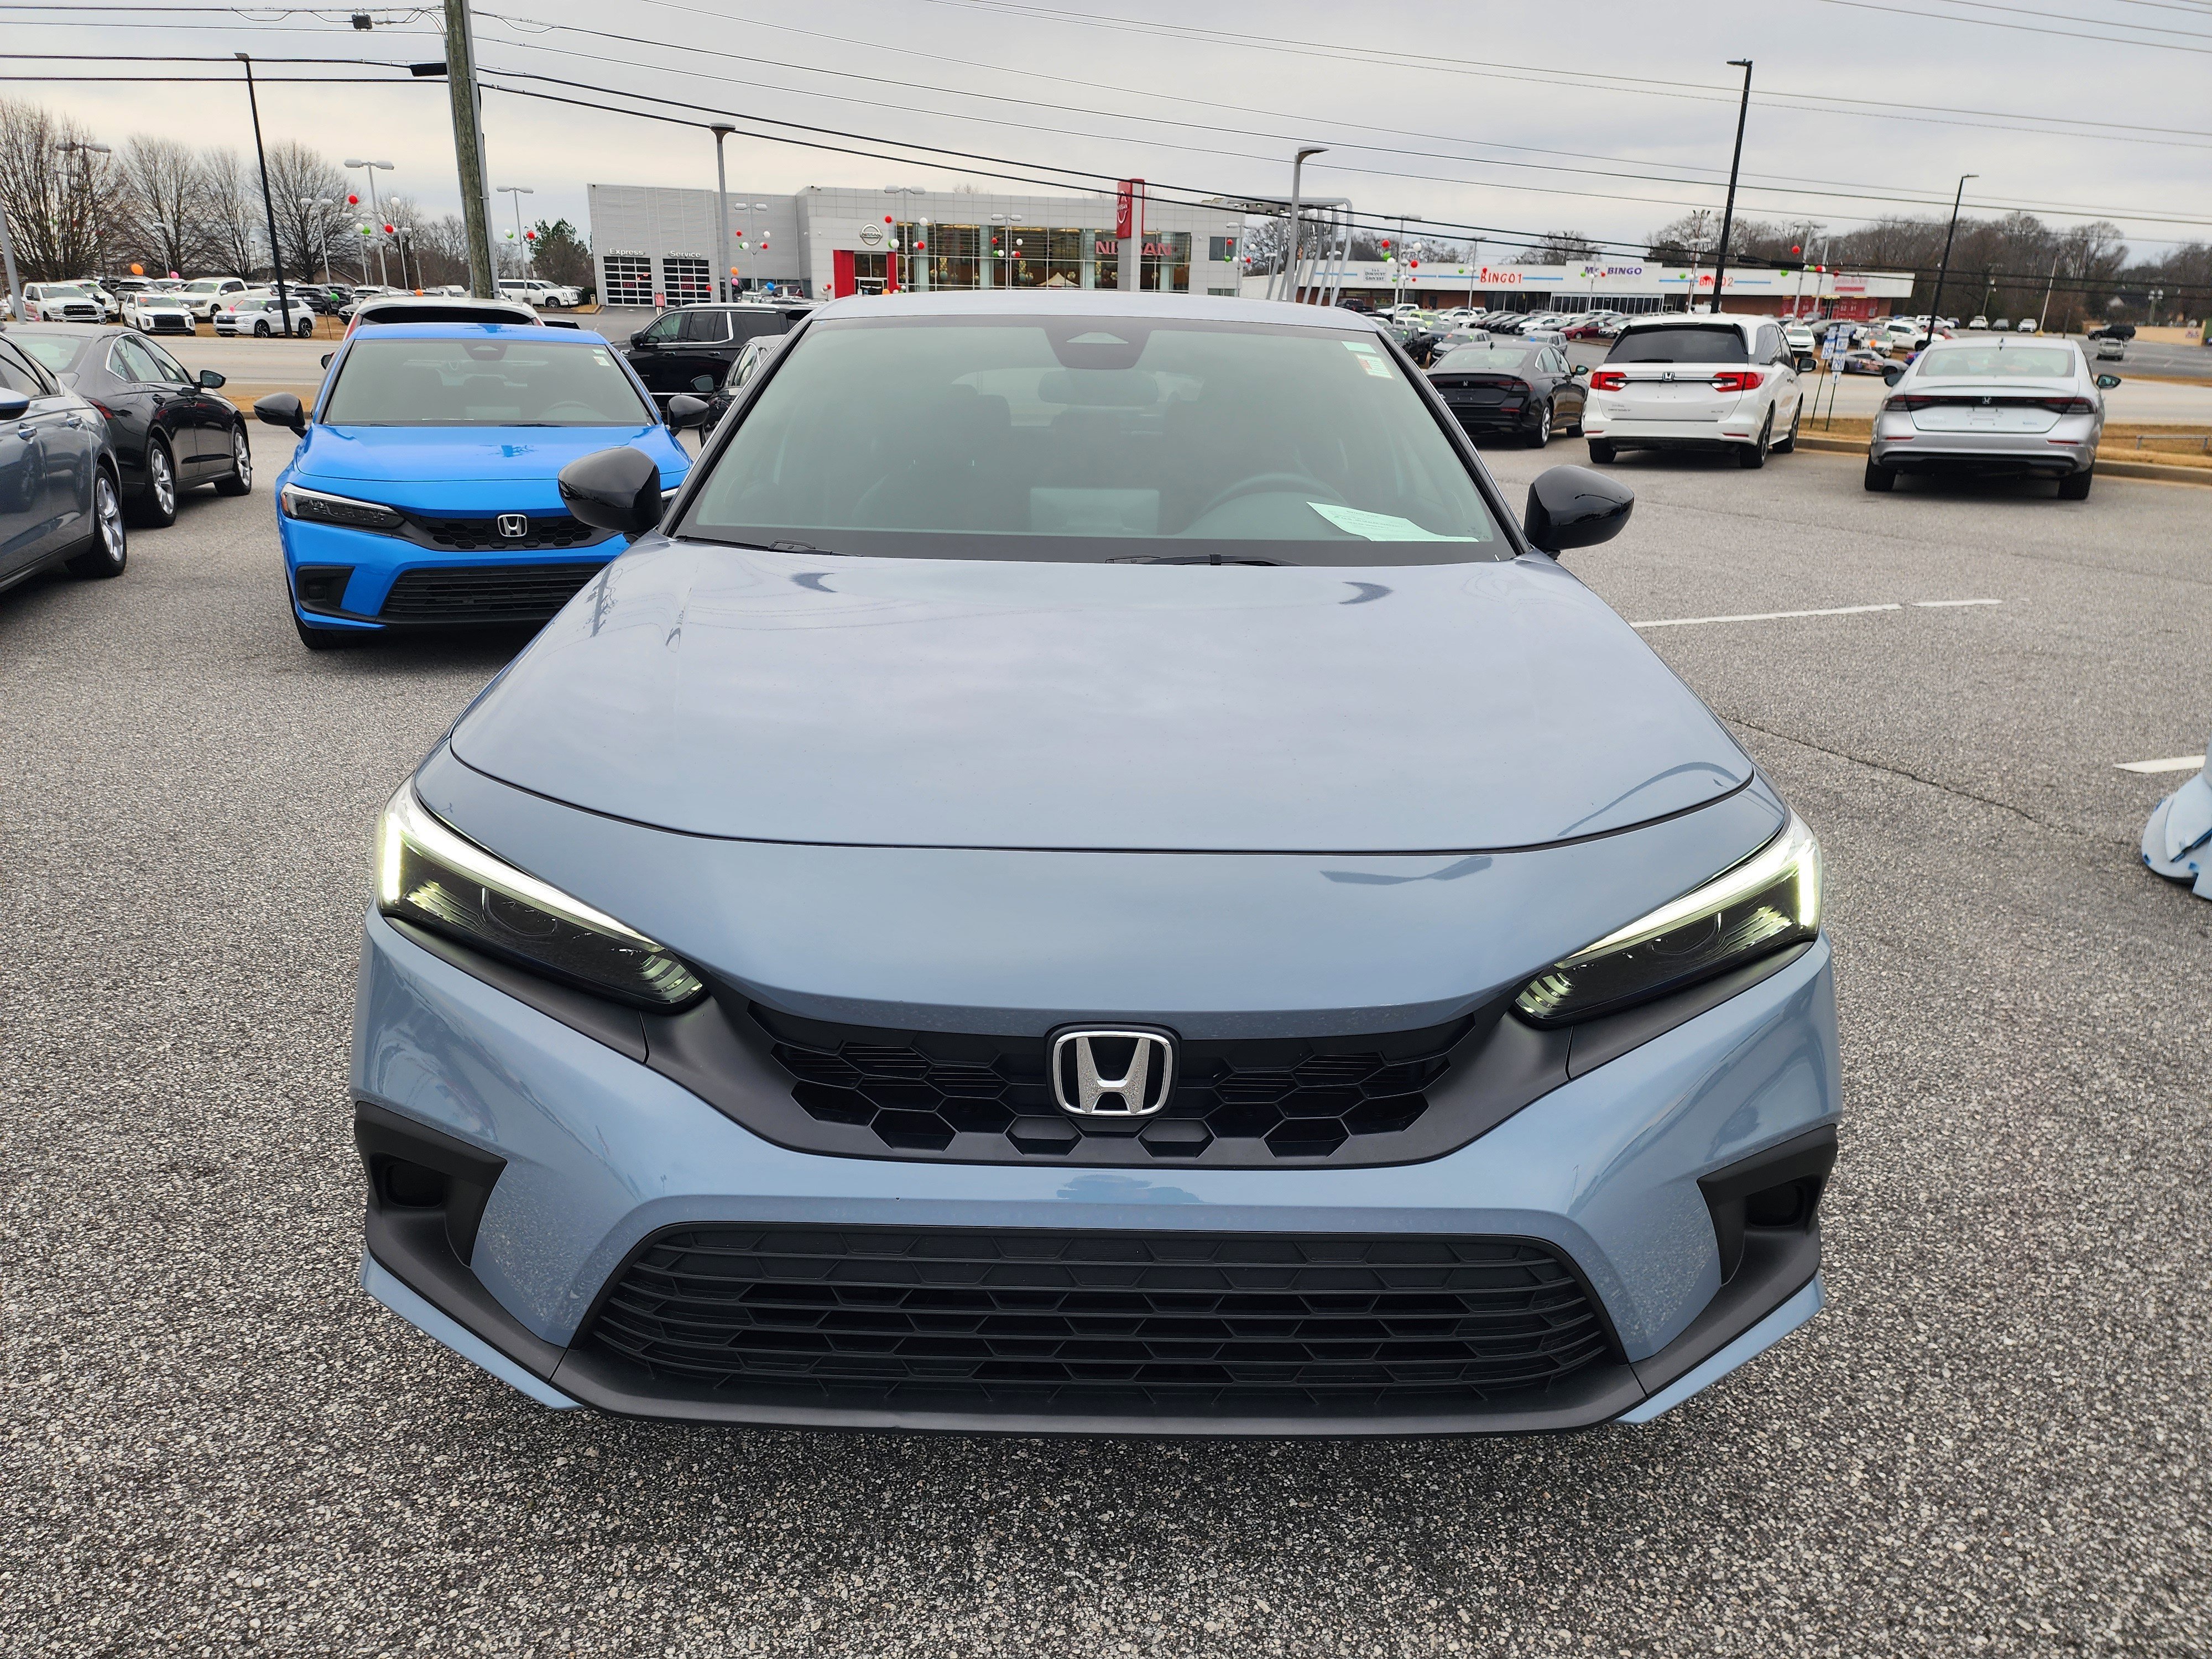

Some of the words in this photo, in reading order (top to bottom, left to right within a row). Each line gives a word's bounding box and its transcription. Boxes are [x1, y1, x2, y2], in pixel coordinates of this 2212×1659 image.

[609, 248, 645, 257] Express
[1095, 241, 1171, 256] NIAN
[670, 250, 701, 258] Service
[1607, 267, 1642, 275] BINGO
